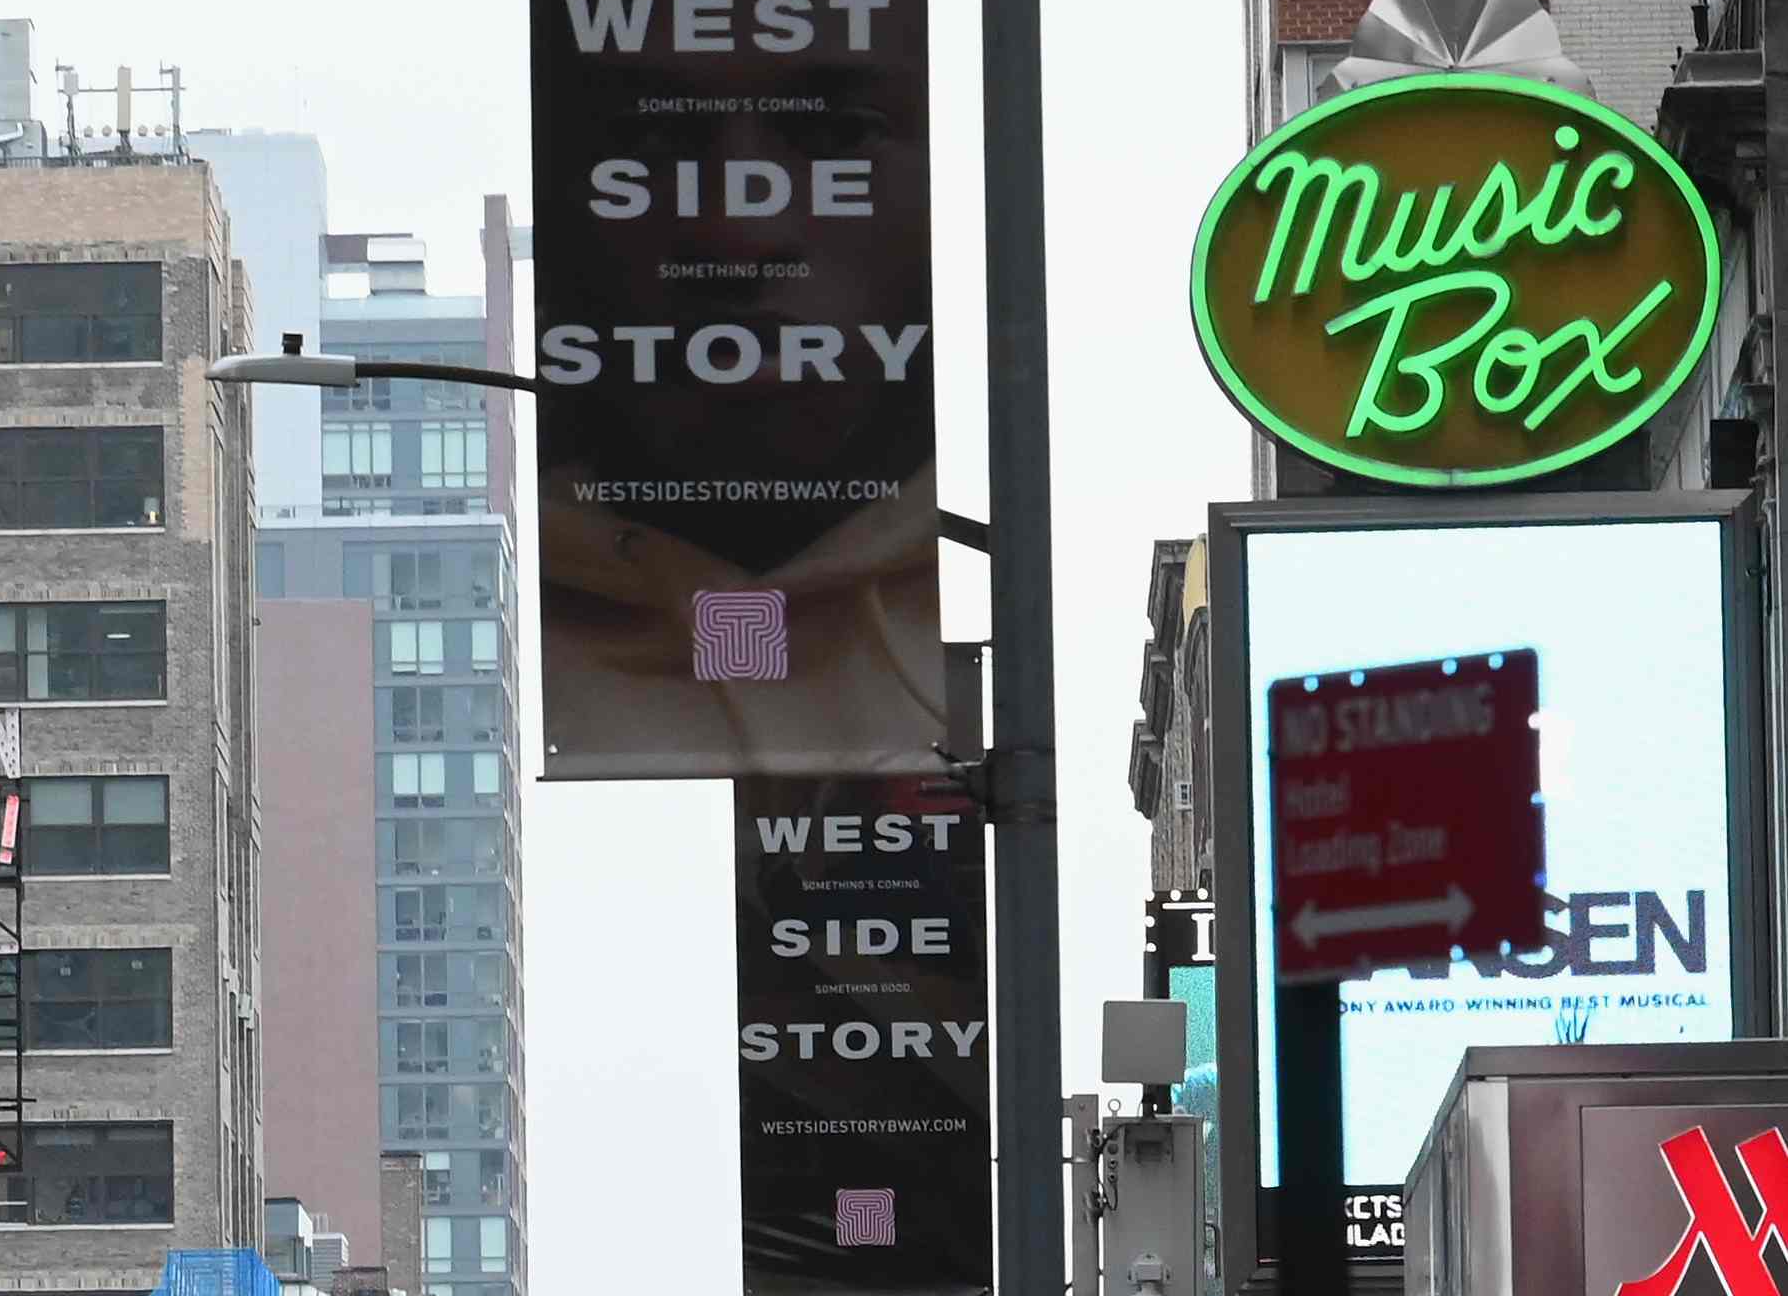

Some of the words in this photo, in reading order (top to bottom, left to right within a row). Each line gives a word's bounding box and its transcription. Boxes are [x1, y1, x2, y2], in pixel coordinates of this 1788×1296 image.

[639, 97, 752, 112] SOMETHING'S
[758, 96, 830, 112] COMING.
[588, 160, 874, 220] SIDE
[1254, 125, 1635, 302] Music
[659, 264, 757, 279] SOMETHING
[540, 324, 927, 385] STORY
[1325, 270, 1672, 437] Box
[573, 480, 900, 502] WESTSIDESTORYBWAY.COM
[756, 814, 960, 854] WEST
[770, 917, 951, 957] SIDE
[1561, 995, 1610, 1009] BEST
[1620, 994, 1708, 1007] MUSICAL
[740, 1019, 985, 1062] STORY
[761, 1117, 967, 1134] WESTSIDESTORYBWAY.COM
